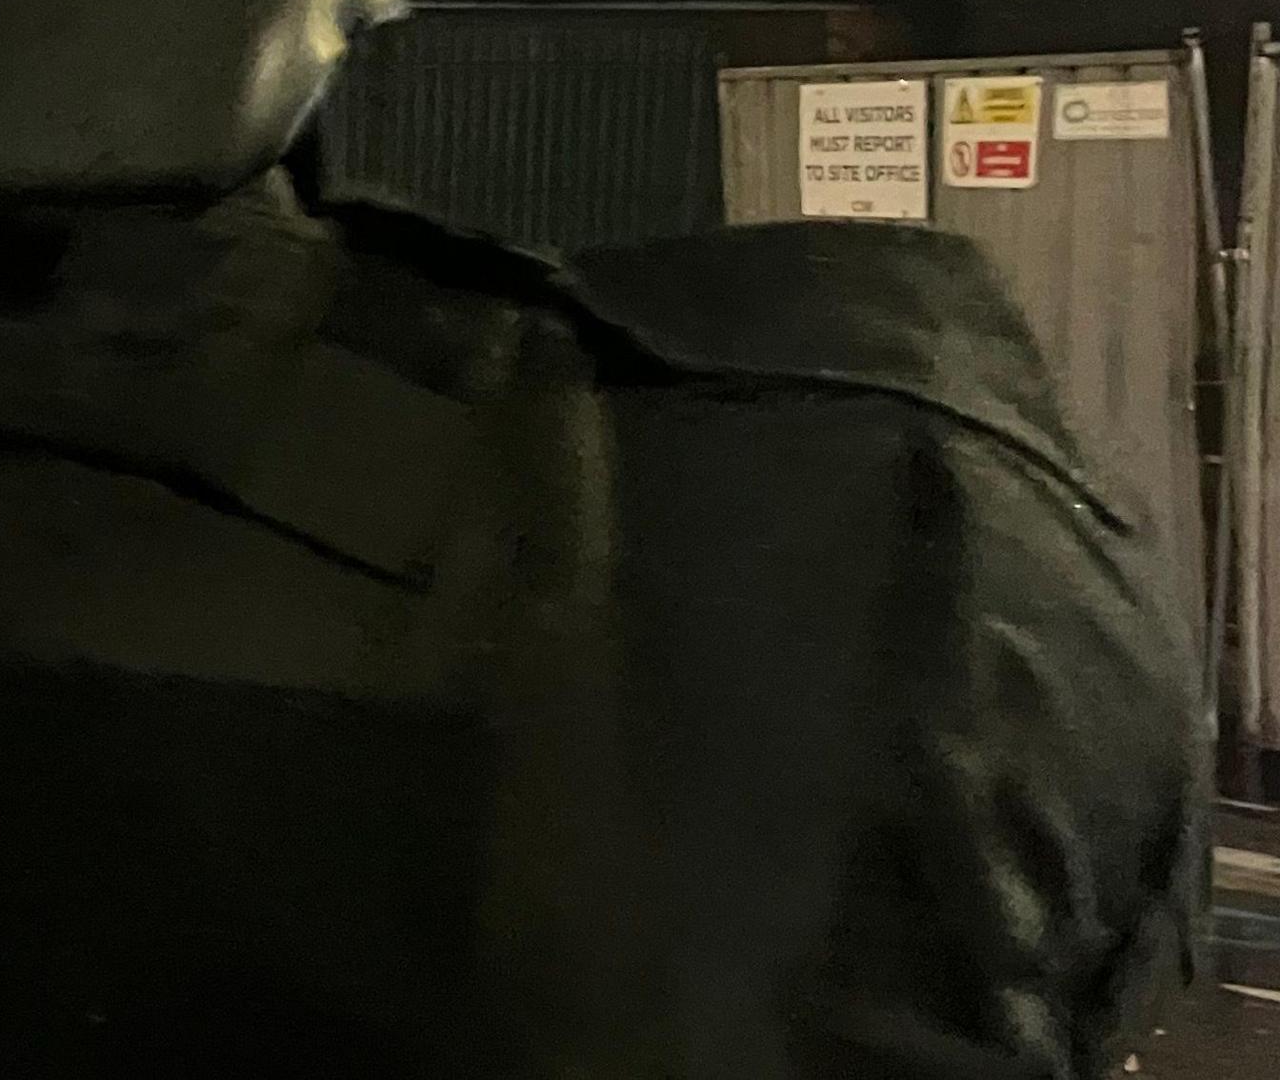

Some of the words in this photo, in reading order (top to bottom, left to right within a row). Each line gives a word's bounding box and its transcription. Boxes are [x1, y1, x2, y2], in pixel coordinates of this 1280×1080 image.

[815, 107, 841, 123] ALL
[845, 105, 914, 122] VISITORS
[810, 135, 849, 152] MUST
[854, 135, 914, 152] REPORT
[805, 164, 824, 181] TO
[828, 164, 861, 182] SITE
[865, 164, 921, 182] OFFICE
